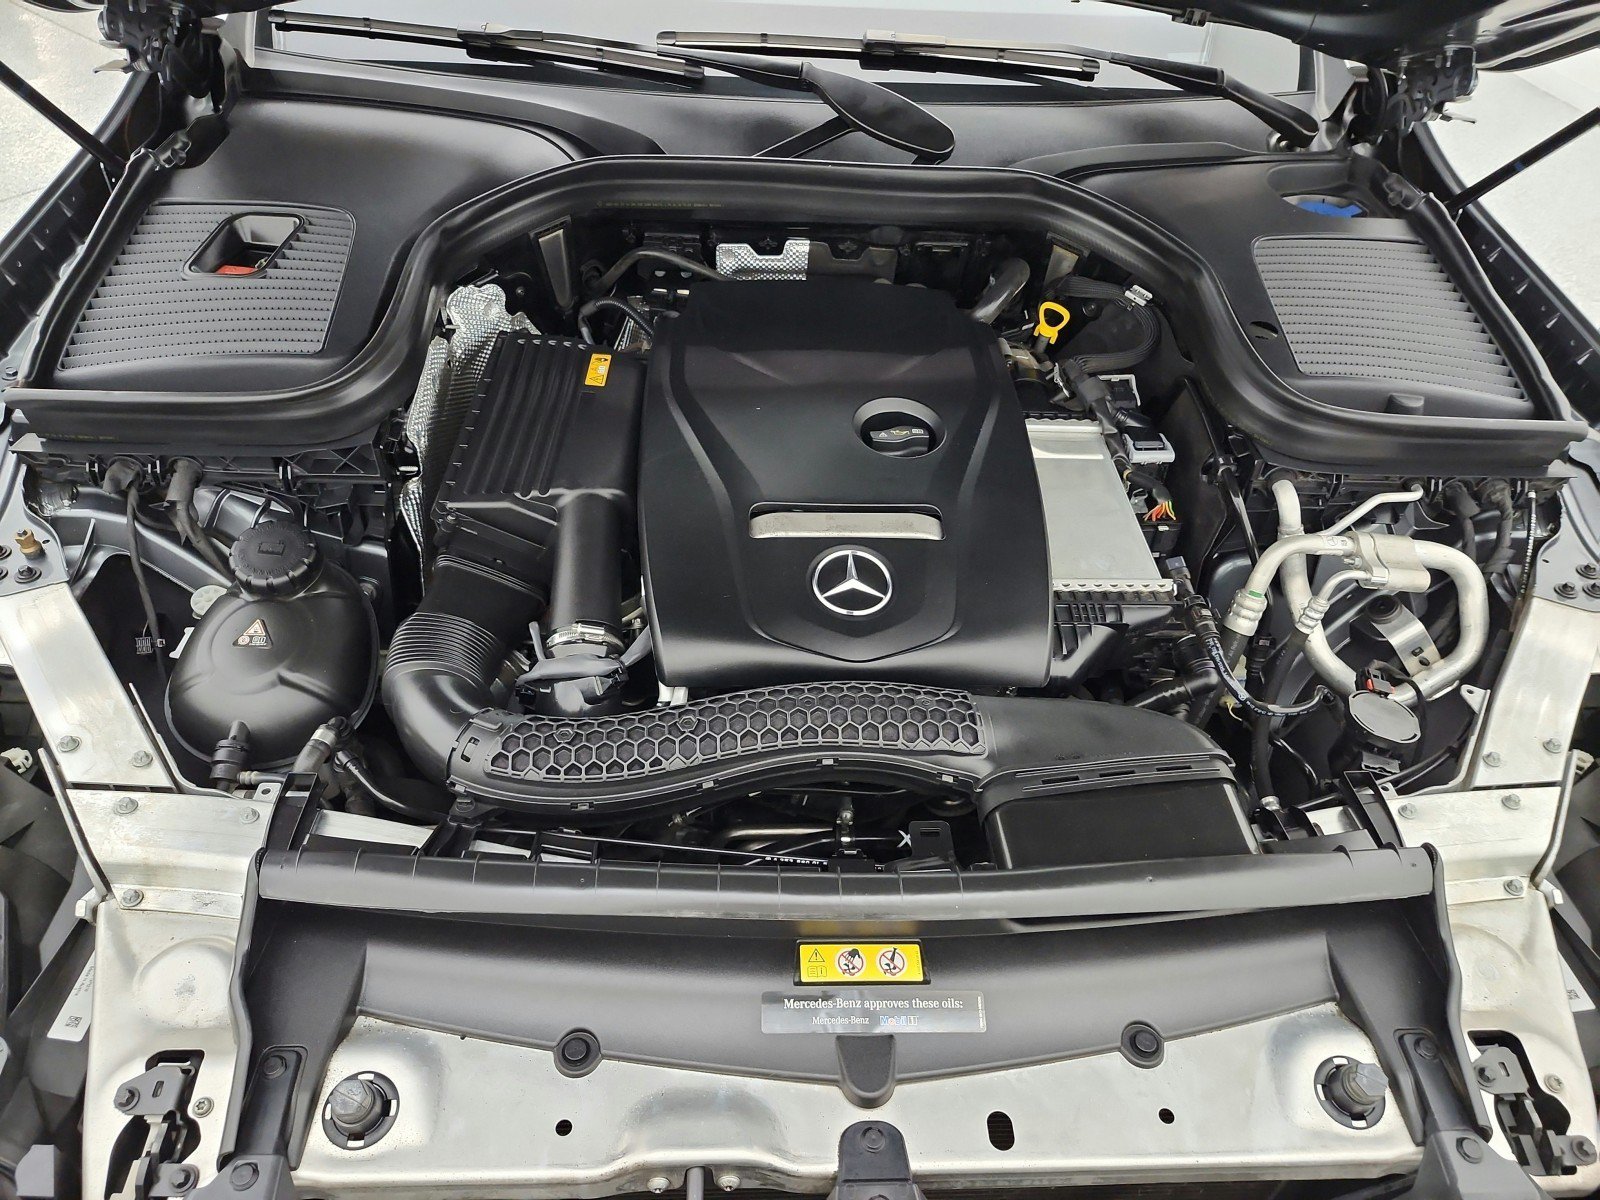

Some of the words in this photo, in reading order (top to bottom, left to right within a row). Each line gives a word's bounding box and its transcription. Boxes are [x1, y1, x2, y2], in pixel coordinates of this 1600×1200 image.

[783, 998, 861, 1009] Mercedes-Benz
[864, 1000, 909, 1011] approves
[912, 998, 939, 1008] these
[942, 998, 963, 1008] oils:
[812, 1015, 869, 1025] Mercedes-Benz
